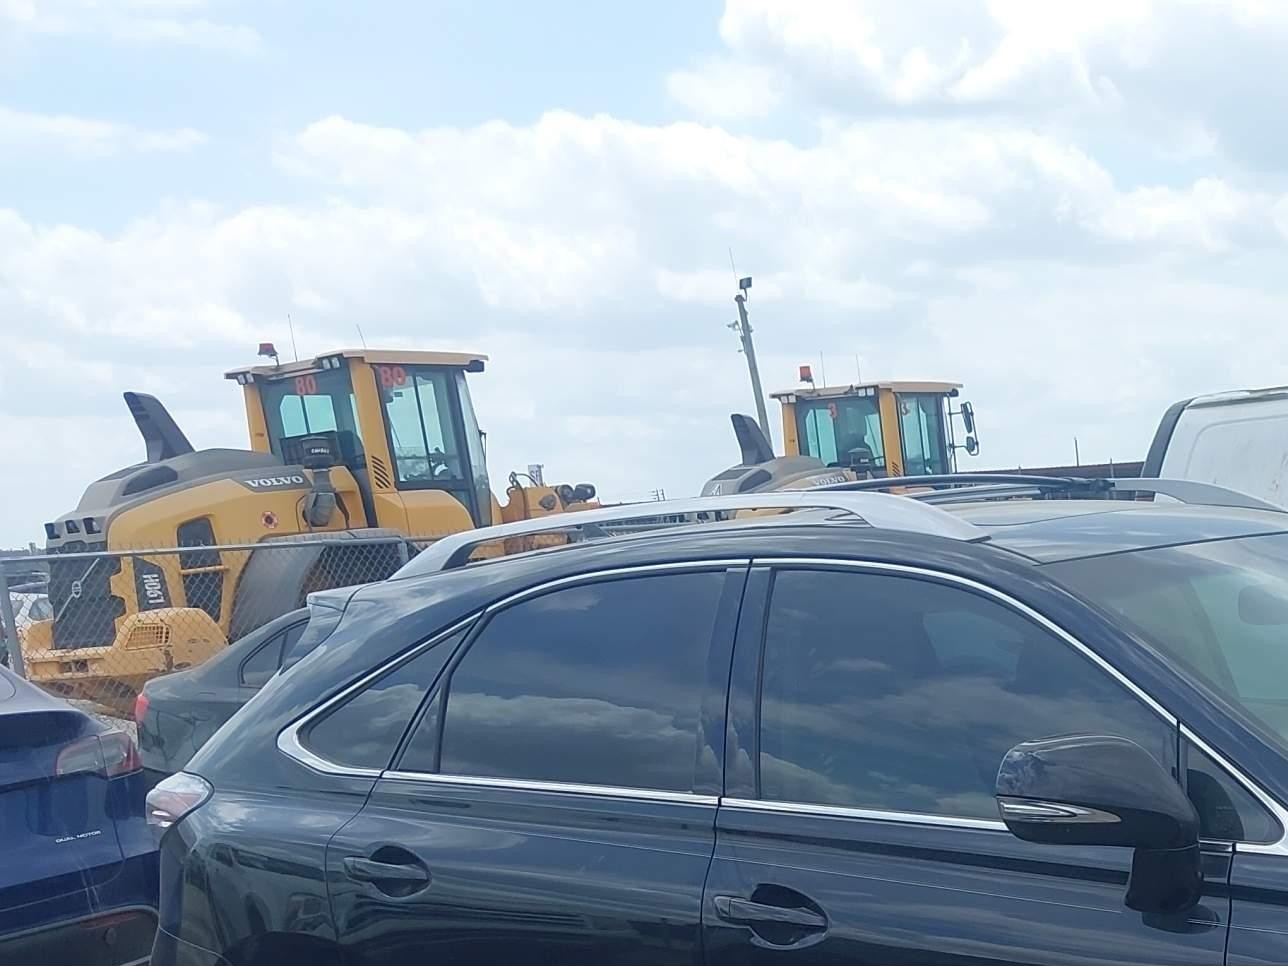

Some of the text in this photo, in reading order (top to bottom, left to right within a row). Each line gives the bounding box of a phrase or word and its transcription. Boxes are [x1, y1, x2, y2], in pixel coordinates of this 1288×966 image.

[295, 375, 317, 395] 80
[381, 366, 407, 386] 80
[244, 476, 304, 487] VOLVO
[142, 573, 165, 604] L90H
[76, 830, 102, 838] MOTOR
